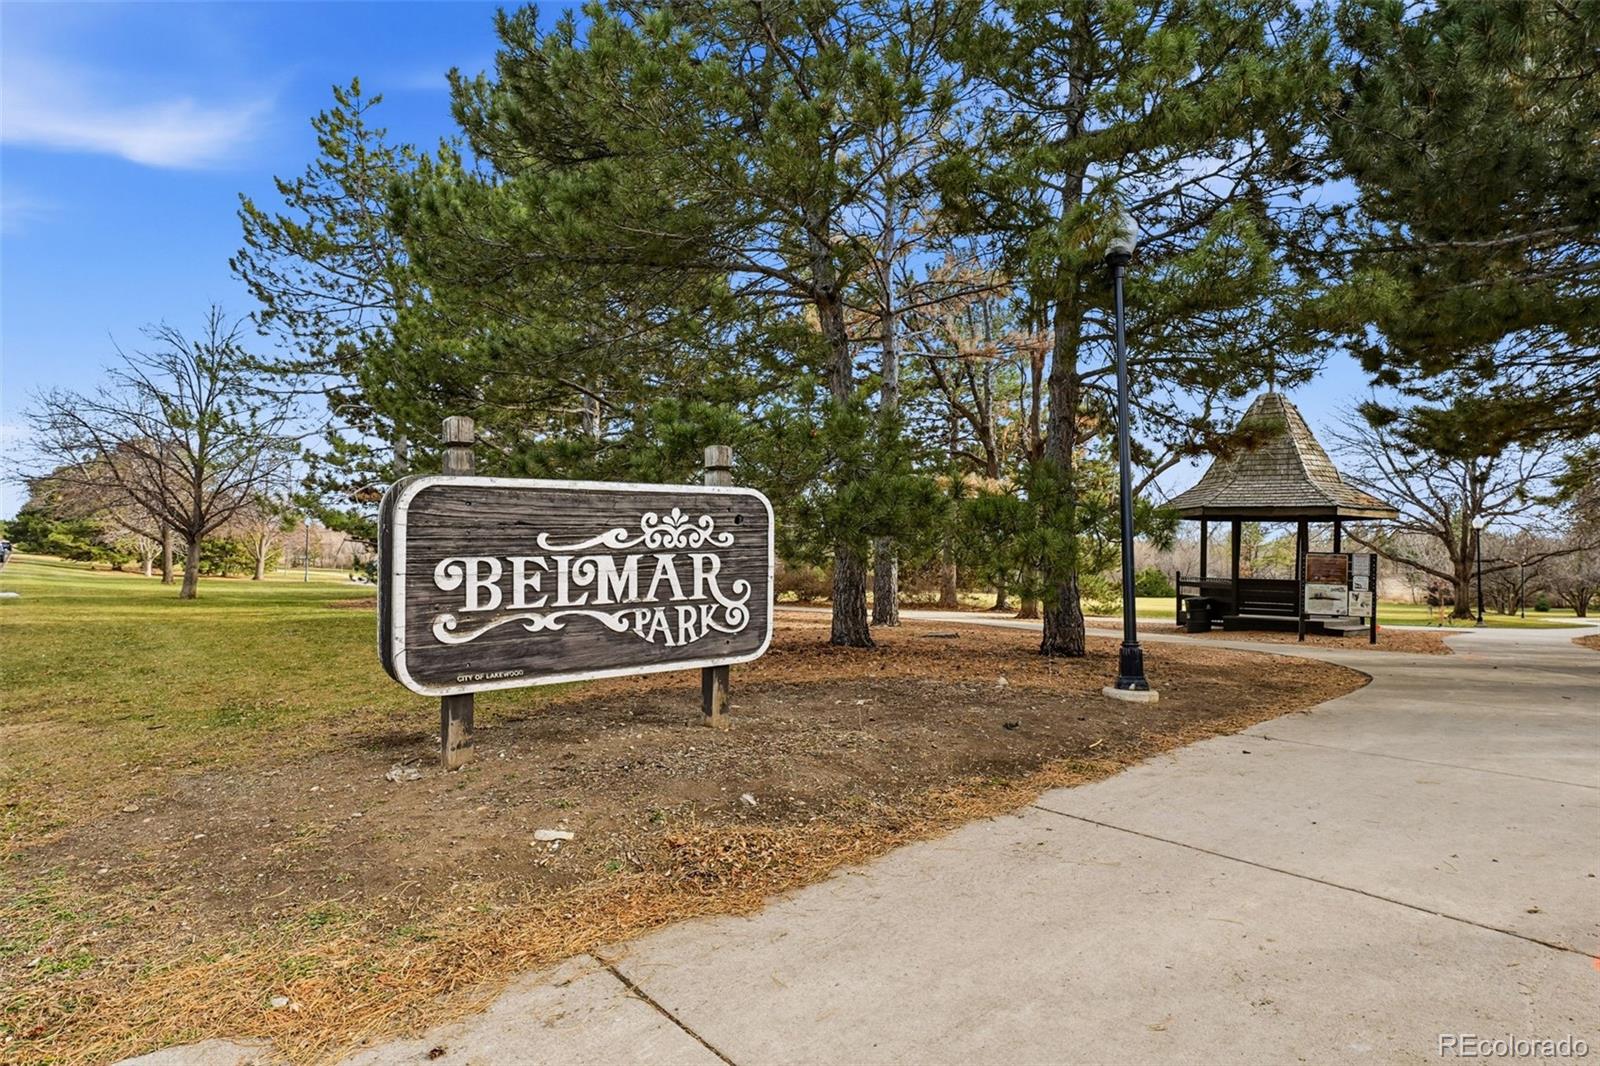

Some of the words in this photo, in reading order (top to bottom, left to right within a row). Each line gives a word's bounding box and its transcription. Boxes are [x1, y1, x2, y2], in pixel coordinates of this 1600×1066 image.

[434, 553, 751, 612] BELMAR
[633, 604, 750, 647] PARK
[457, 674, 473, 682] CITY
[475, 673, 484, 681] OF
[486, 670, 524, 679] LAKEWOOD
